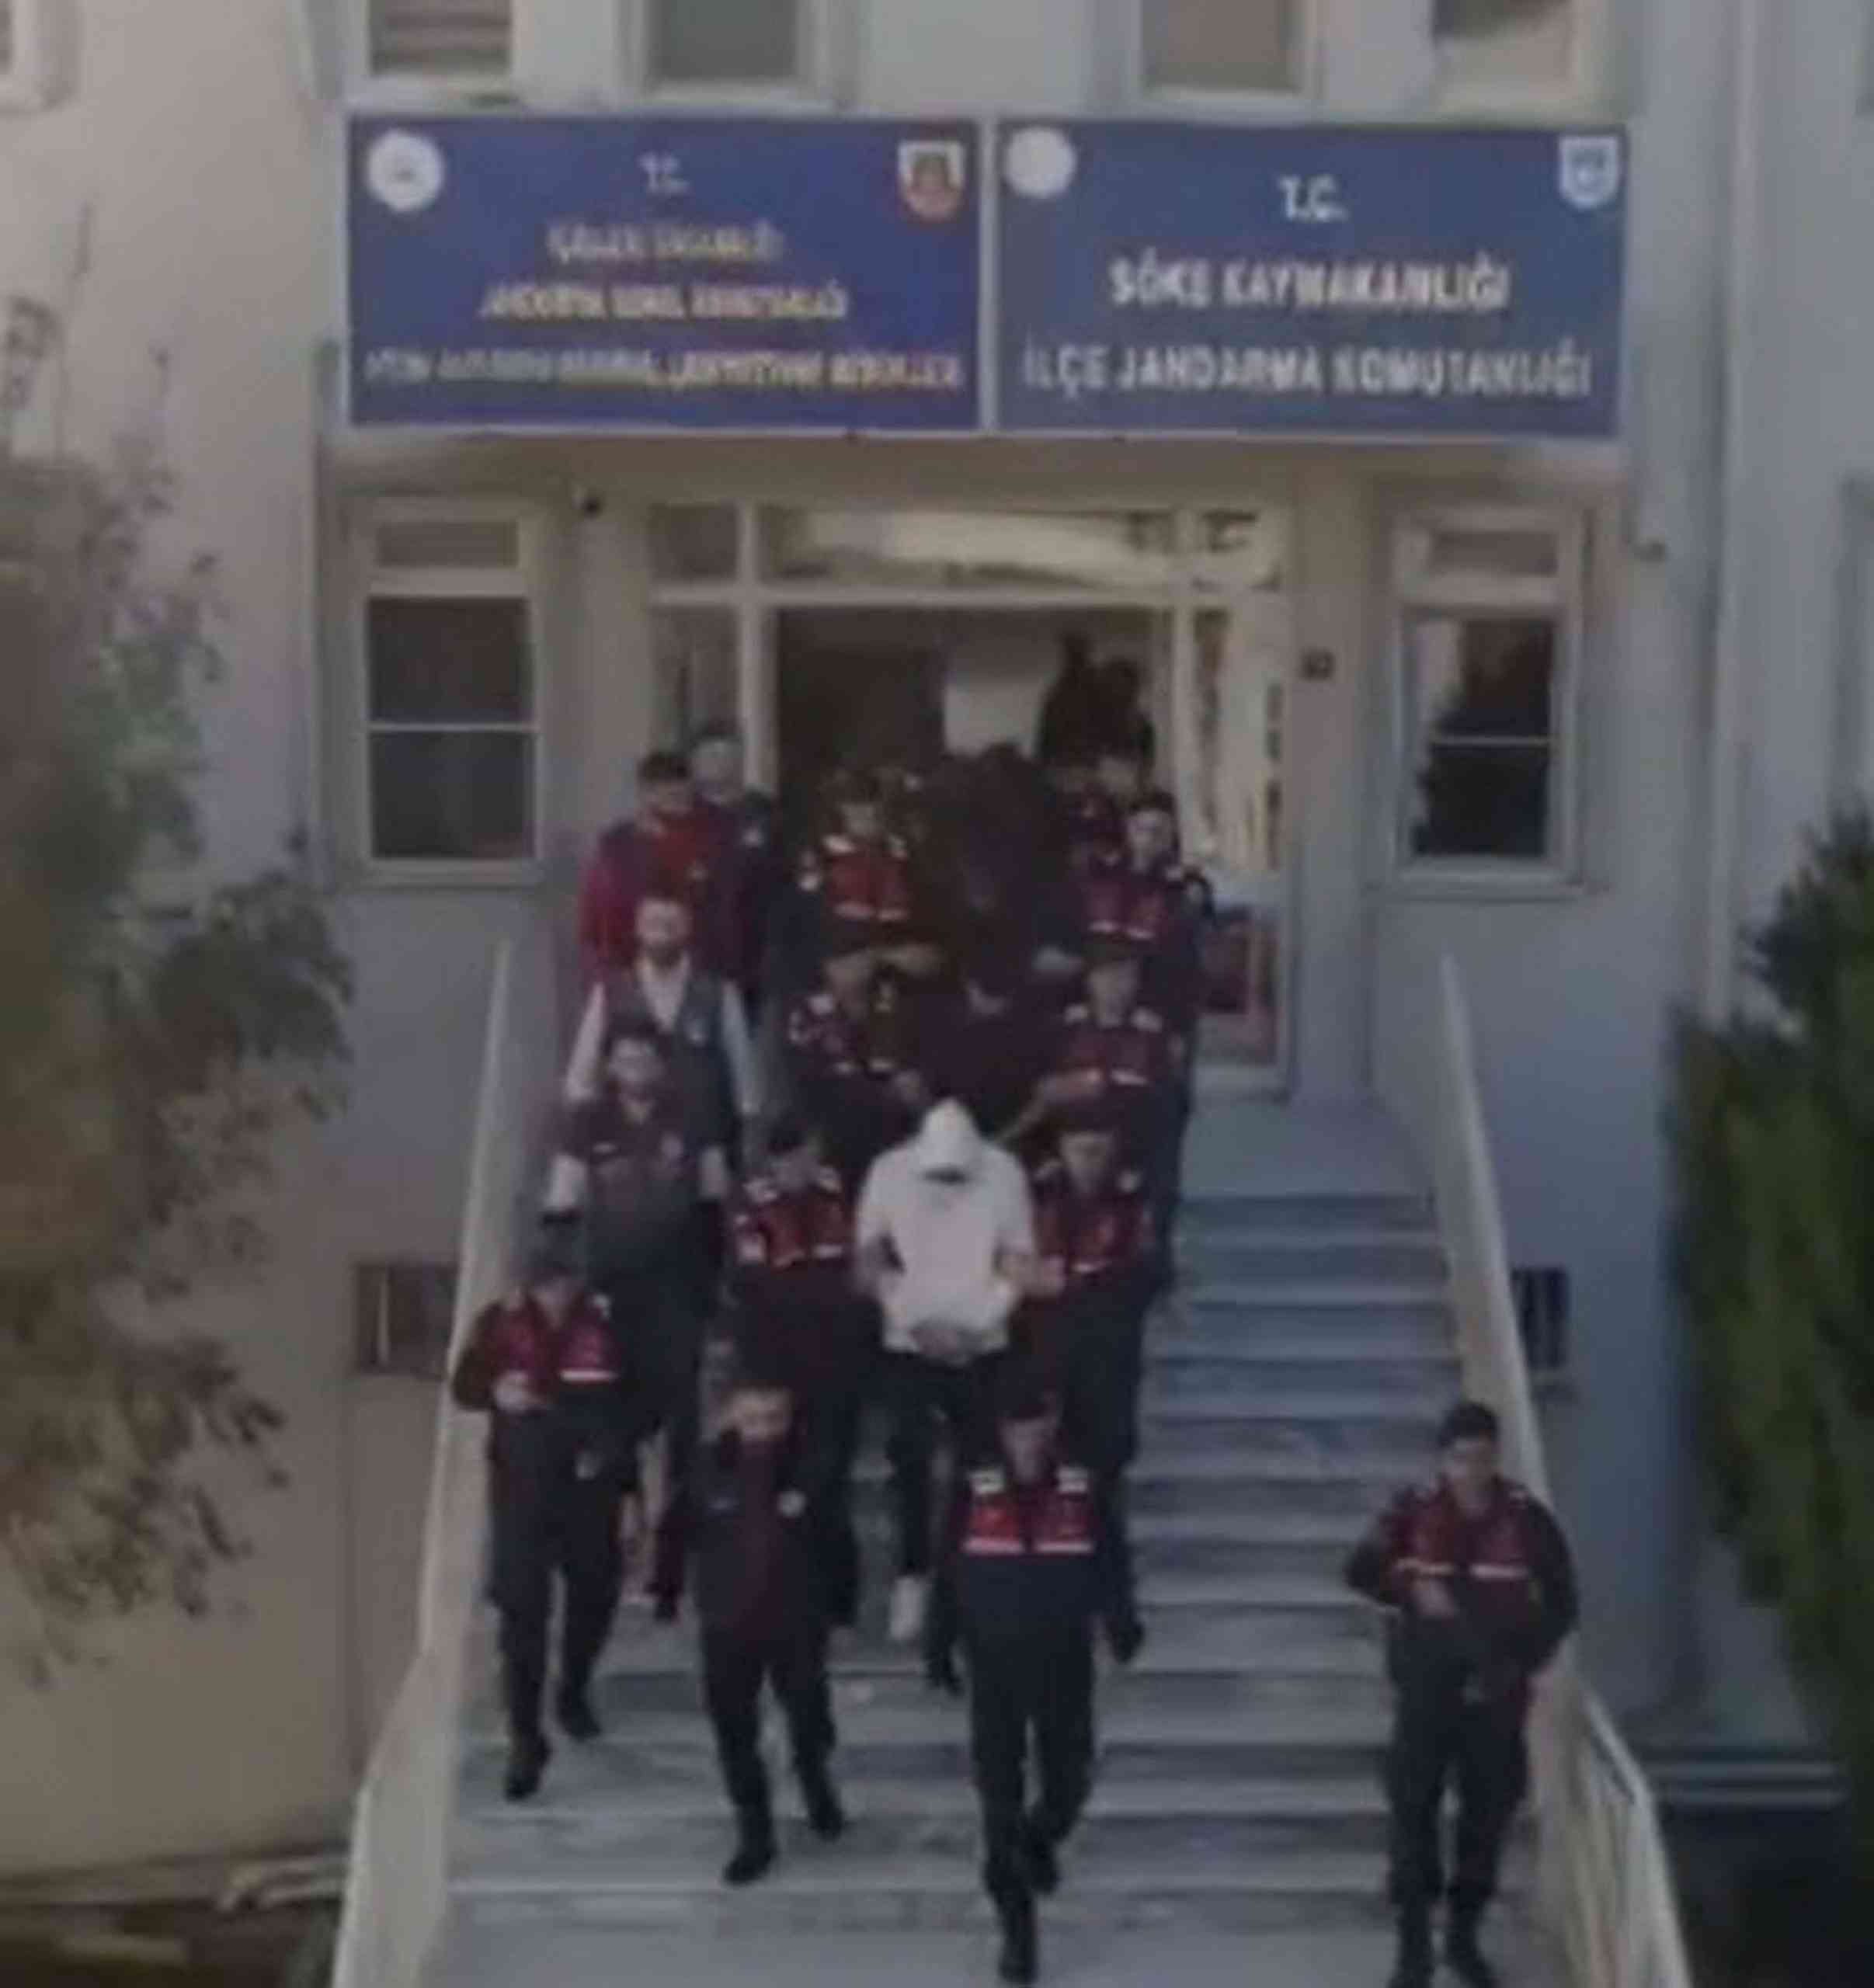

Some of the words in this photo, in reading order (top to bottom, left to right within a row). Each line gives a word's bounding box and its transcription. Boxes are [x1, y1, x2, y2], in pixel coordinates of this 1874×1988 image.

[1279, 176, 1347, 222] T.C.
[1108, 247, 1210, 308] SÖKE
[1118, 345, 1323, 393] JANDARMA
[1333, 340, 1593, 398] KOMUTANLIĞI
